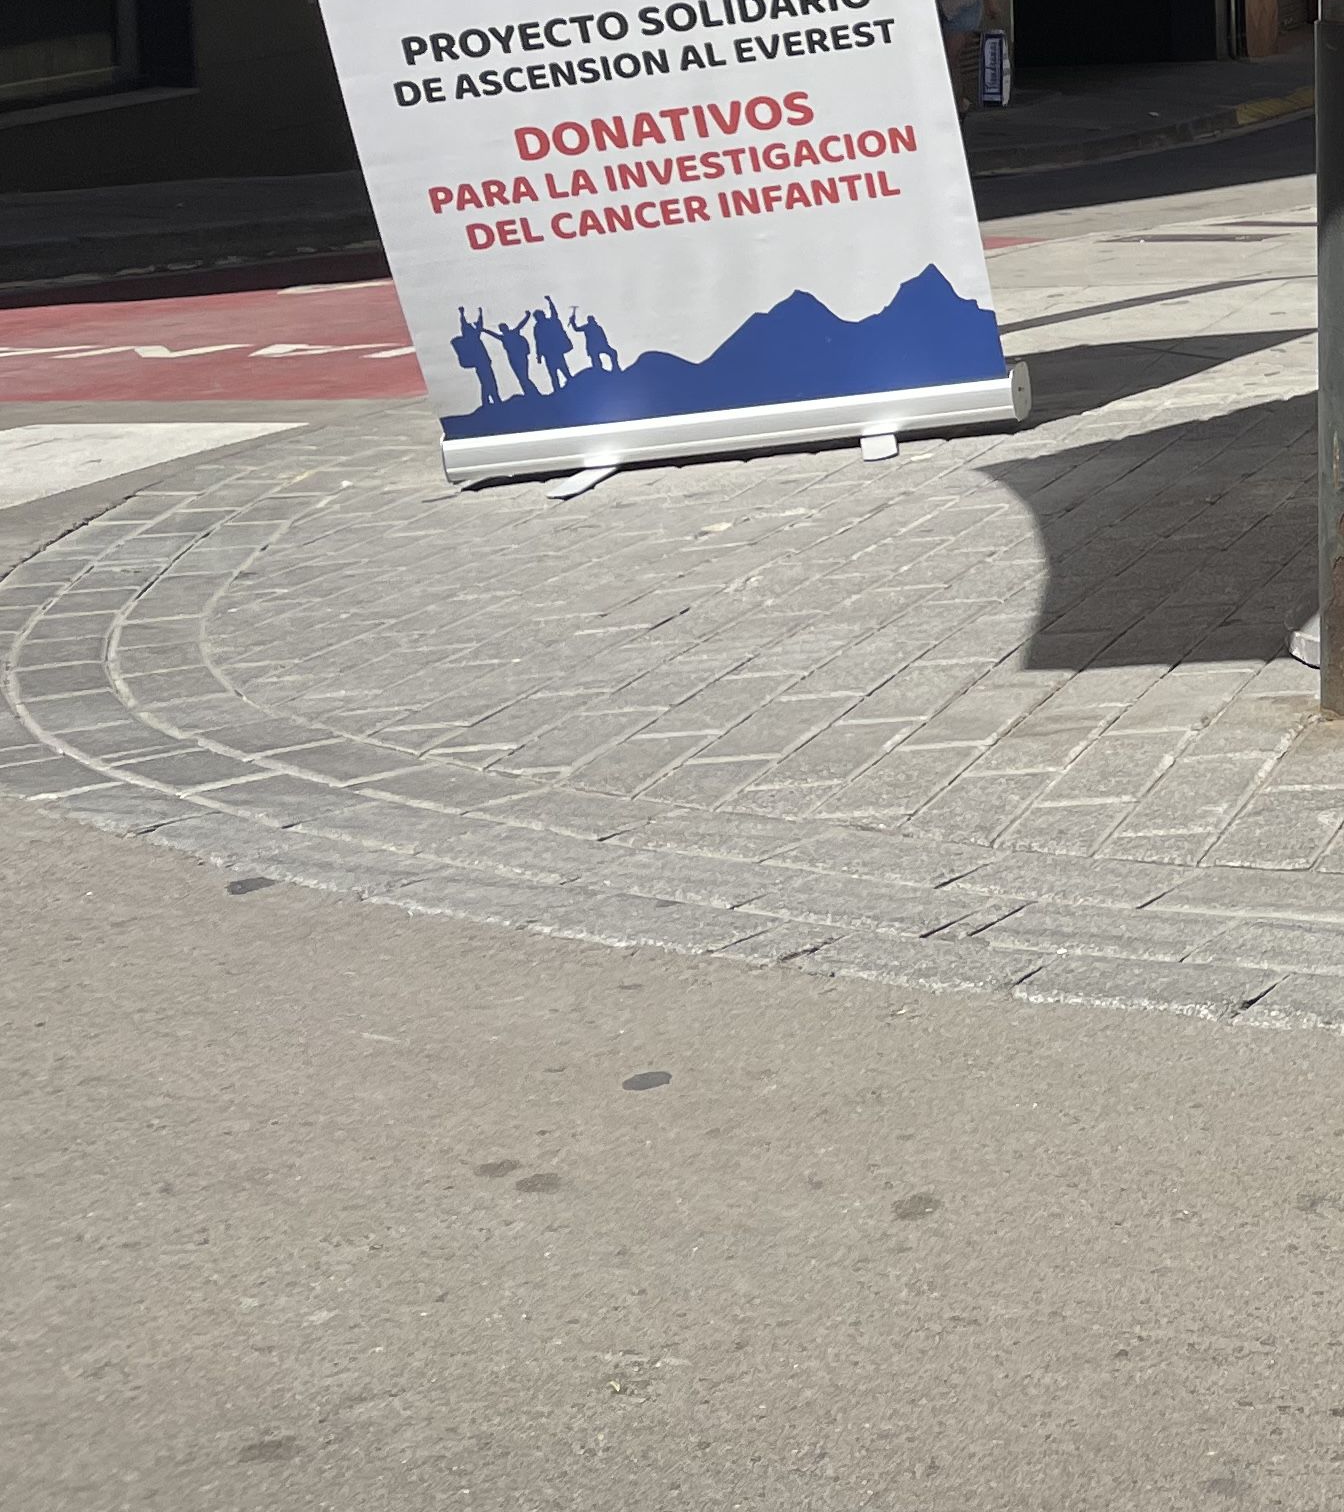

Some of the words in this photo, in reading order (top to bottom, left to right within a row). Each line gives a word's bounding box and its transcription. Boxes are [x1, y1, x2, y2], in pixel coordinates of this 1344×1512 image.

[393, 76, 446, 107] DE
[455, 47, 671, 101] ASCENSION
[679, 41, 727, 72] AL
[734, 17, 897, 66] EVEREST
[401, 11, 630, 66] PROYECTO
[514, 90, 815, 162] DONATIVOS
[427, 176, 539, 214] PARA
[545, 168, 599, 199] LA
[605, 124, 918, 192] INVESTIGACION
[466, 216, 544, 251] DEL
[550, 194, 710, 241] CANCER
[718, 169, 901, 219] INFANTIL
